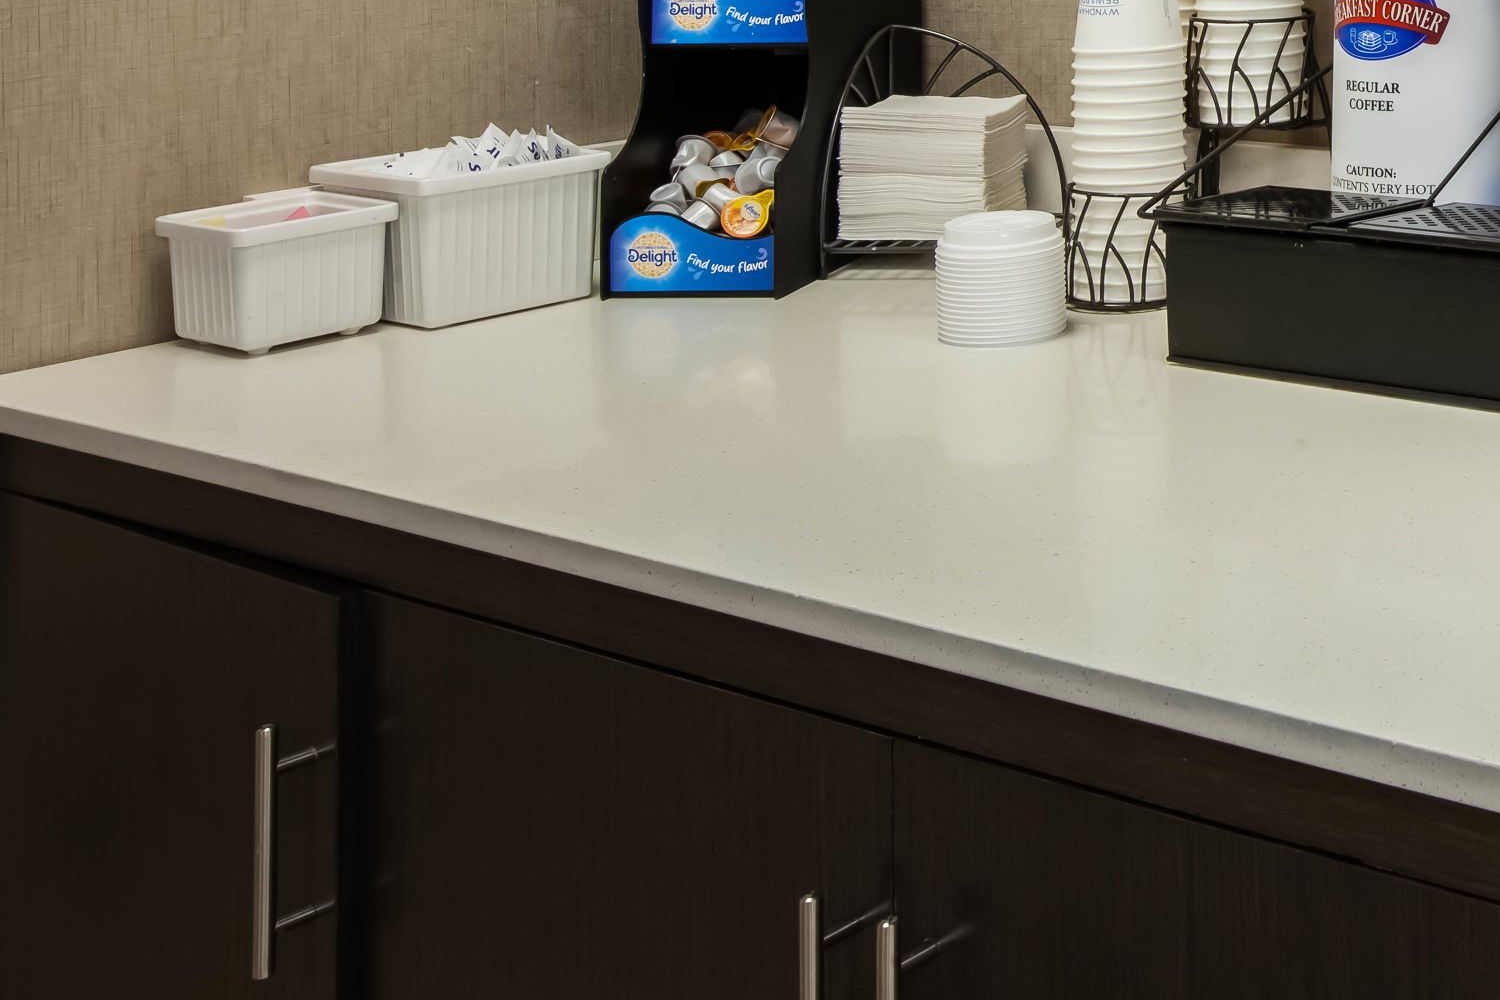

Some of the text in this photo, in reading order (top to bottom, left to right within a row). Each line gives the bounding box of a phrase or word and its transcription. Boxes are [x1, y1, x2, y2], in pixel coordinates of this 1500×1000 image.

[669, 2, 717, 19] Delight
[726, 6, 749, 22] Find
[749, 15, 772, 26] your
[1382, 0, 1443, 33] CORNER
[1346, 79, 1400, 94] REGULAR
[1349, 98, 1394, 112] COFFEE
[1346, 164, 1397, 179] CAUTION:
[1372, 183, 1402, 195] VERY
[1405, 184, 1436, 195] HOT
[628, 249, 677, 267] Delight
[686, 253, 711, 270] Find
[710, 262, 735, 274] your
